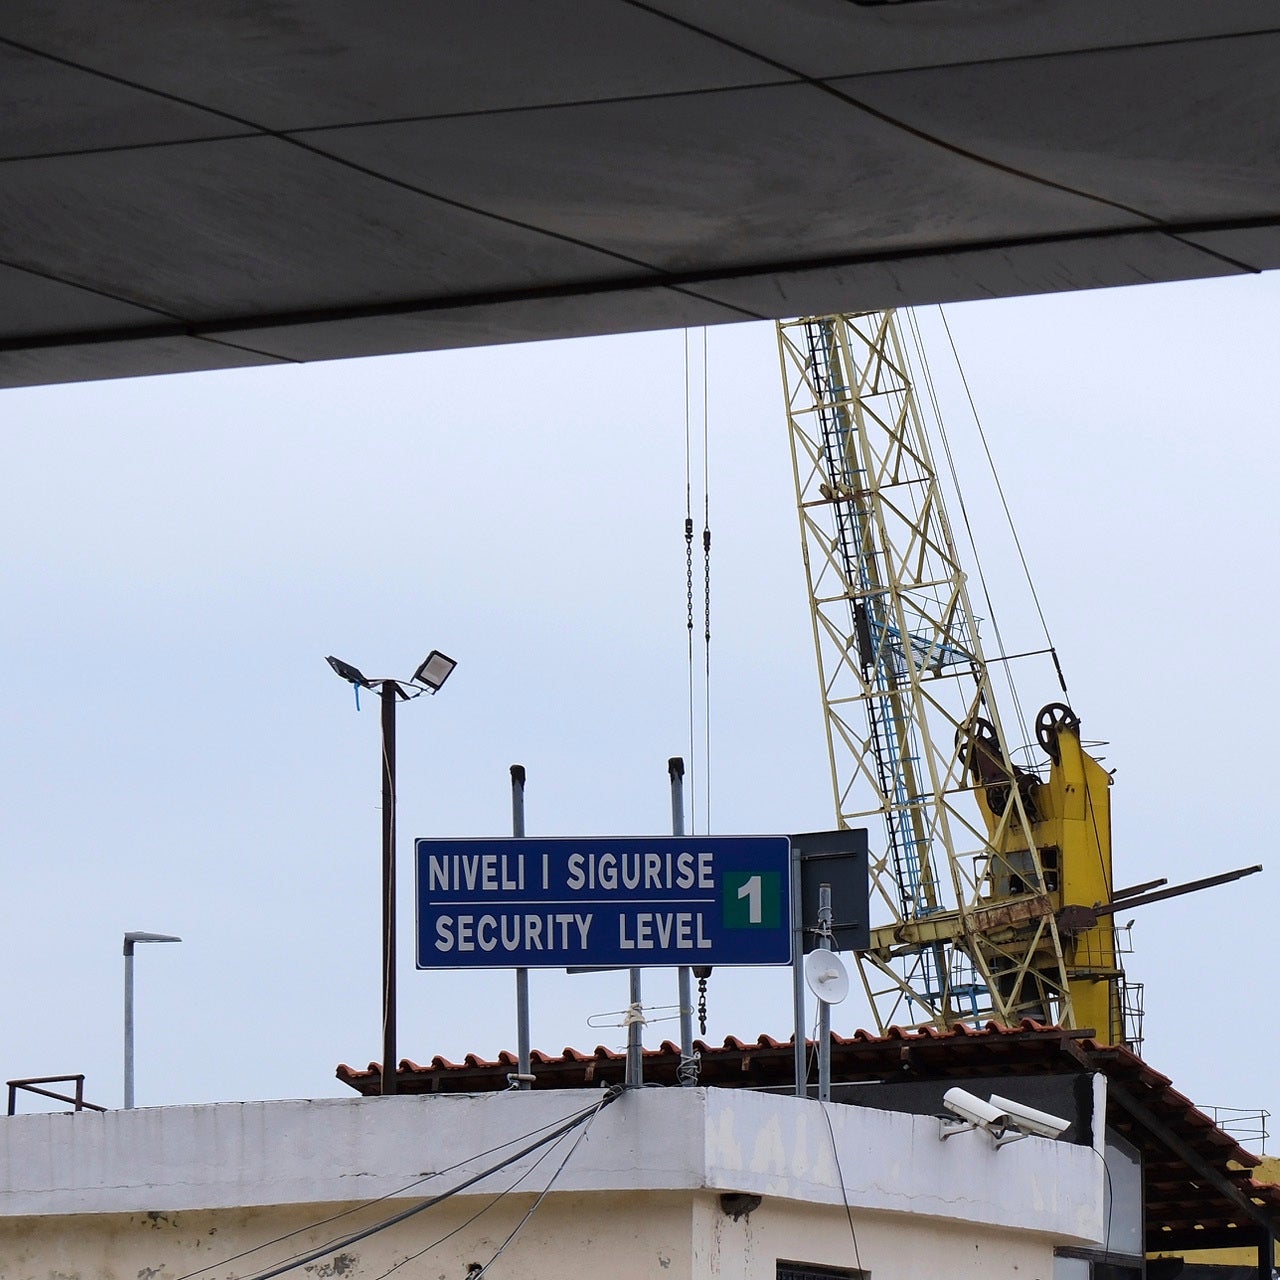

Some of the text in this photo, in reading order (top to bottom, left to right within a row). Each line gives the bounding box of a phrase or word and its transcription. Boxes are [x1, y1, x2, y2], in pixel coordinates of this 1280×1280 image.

[429, 852, 714, 890] NIVELI I SIGURISE
[737, 875, 762, 923] 1
[434, 912, 713, 952] SECURITY LEVEL
